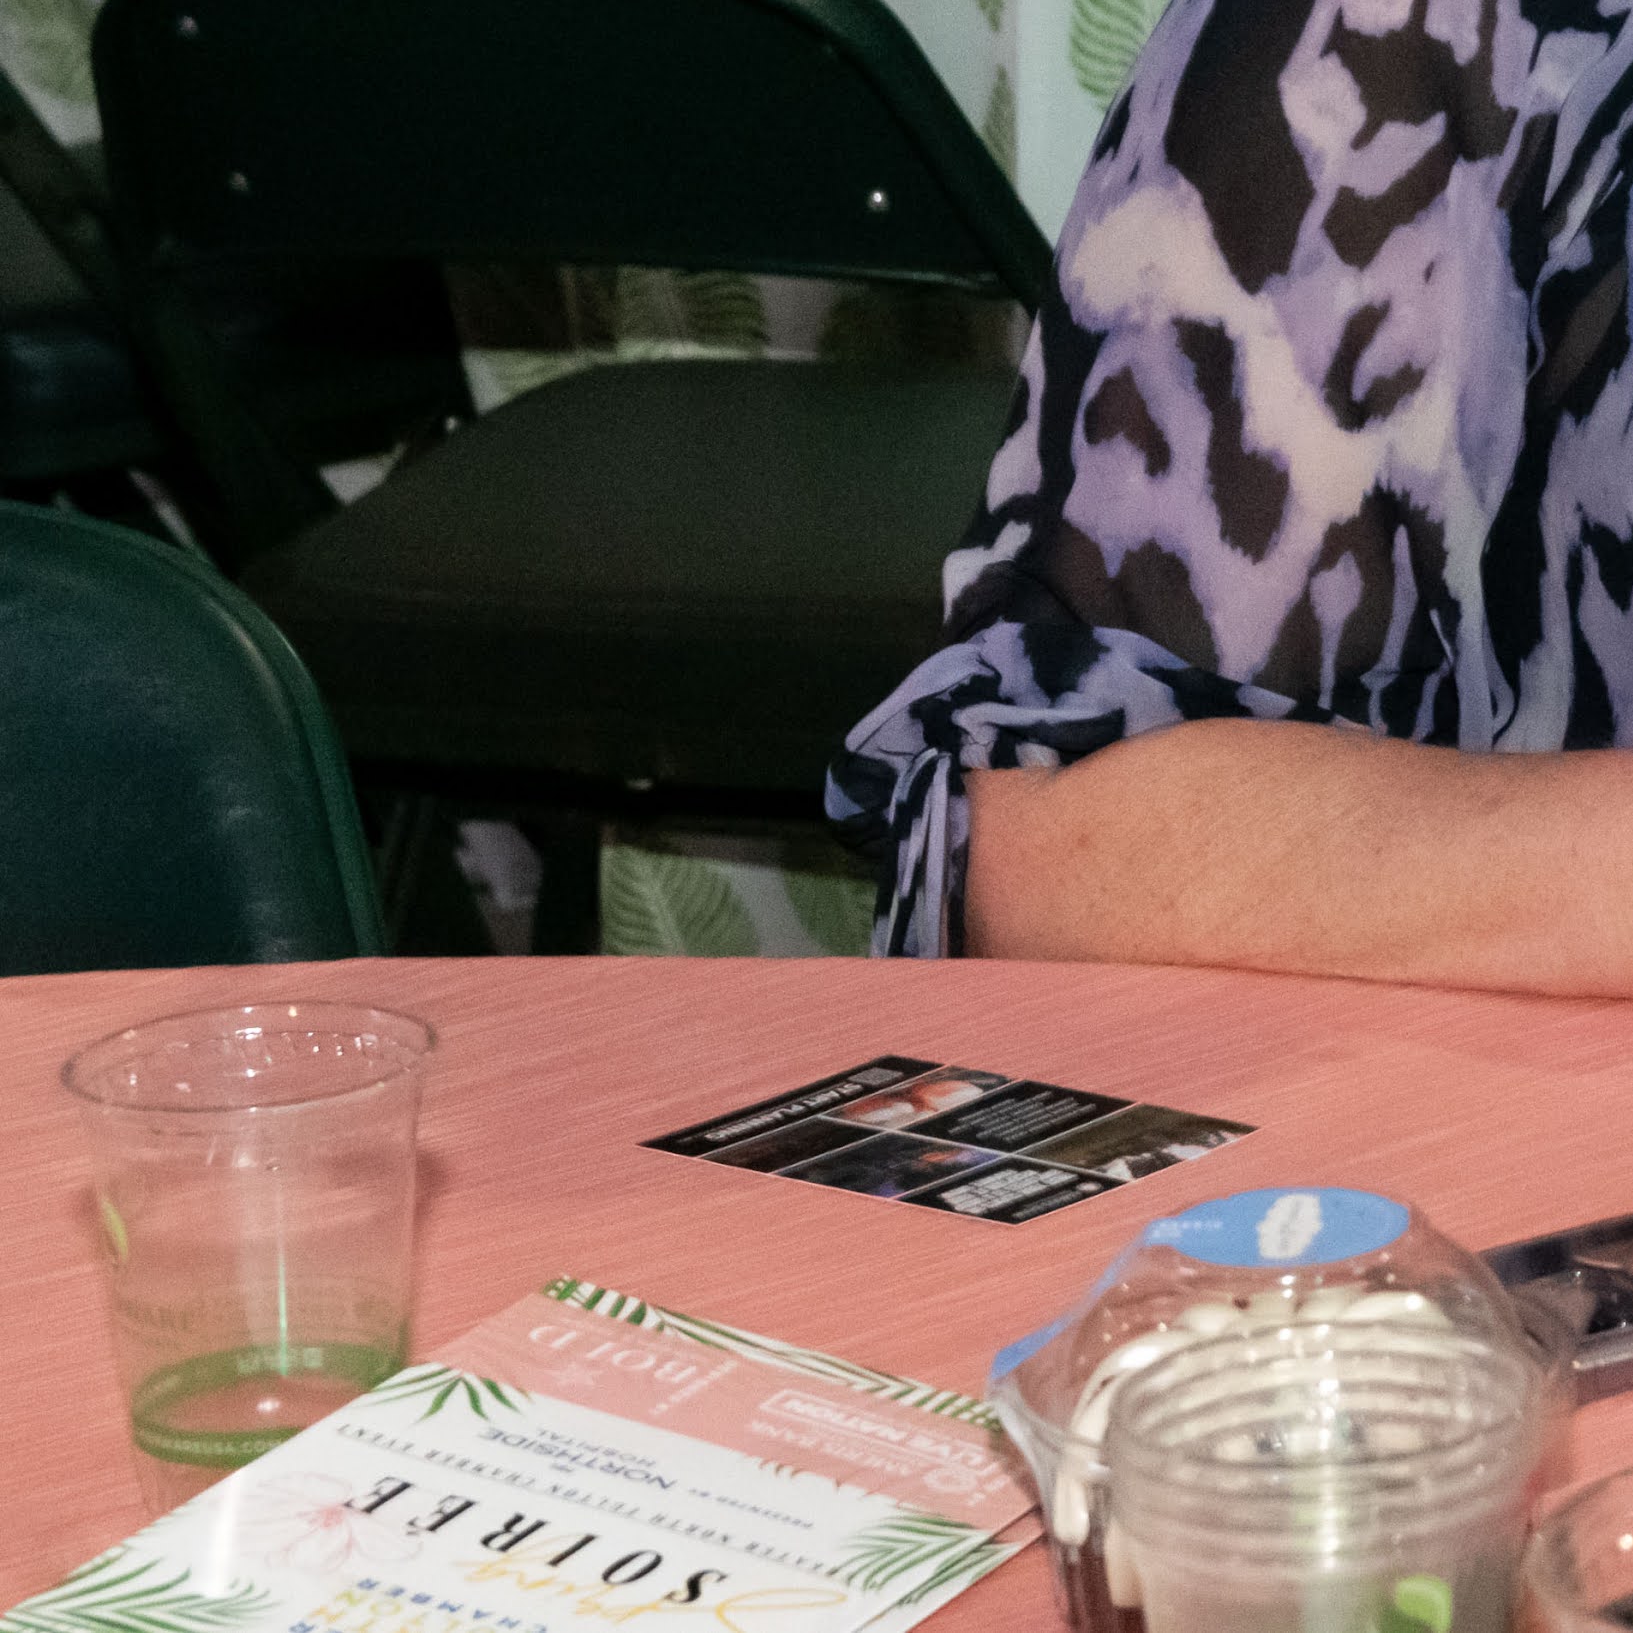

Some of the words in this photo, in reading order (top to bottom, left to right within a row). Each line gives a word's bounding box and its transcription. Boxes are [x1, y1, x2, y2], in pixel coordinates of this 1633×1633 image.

[528, 1324, 698, 1385] BOLD
[336, 1423, 416, 1454] EVENT
[783, 1397, 908, 1443] NATION
[424, 1447, 537, 1487] CHAMBER
[478, 1426, 679, 1491] NORTHSIDE
[536, 1426, 656, 1468] HOSPITAL
[550, 1483, 641, 1518] FULTON
[343, 1475, 728, 1604] SOIRÉE
[650, 1512, 733, 1545] NORTH
